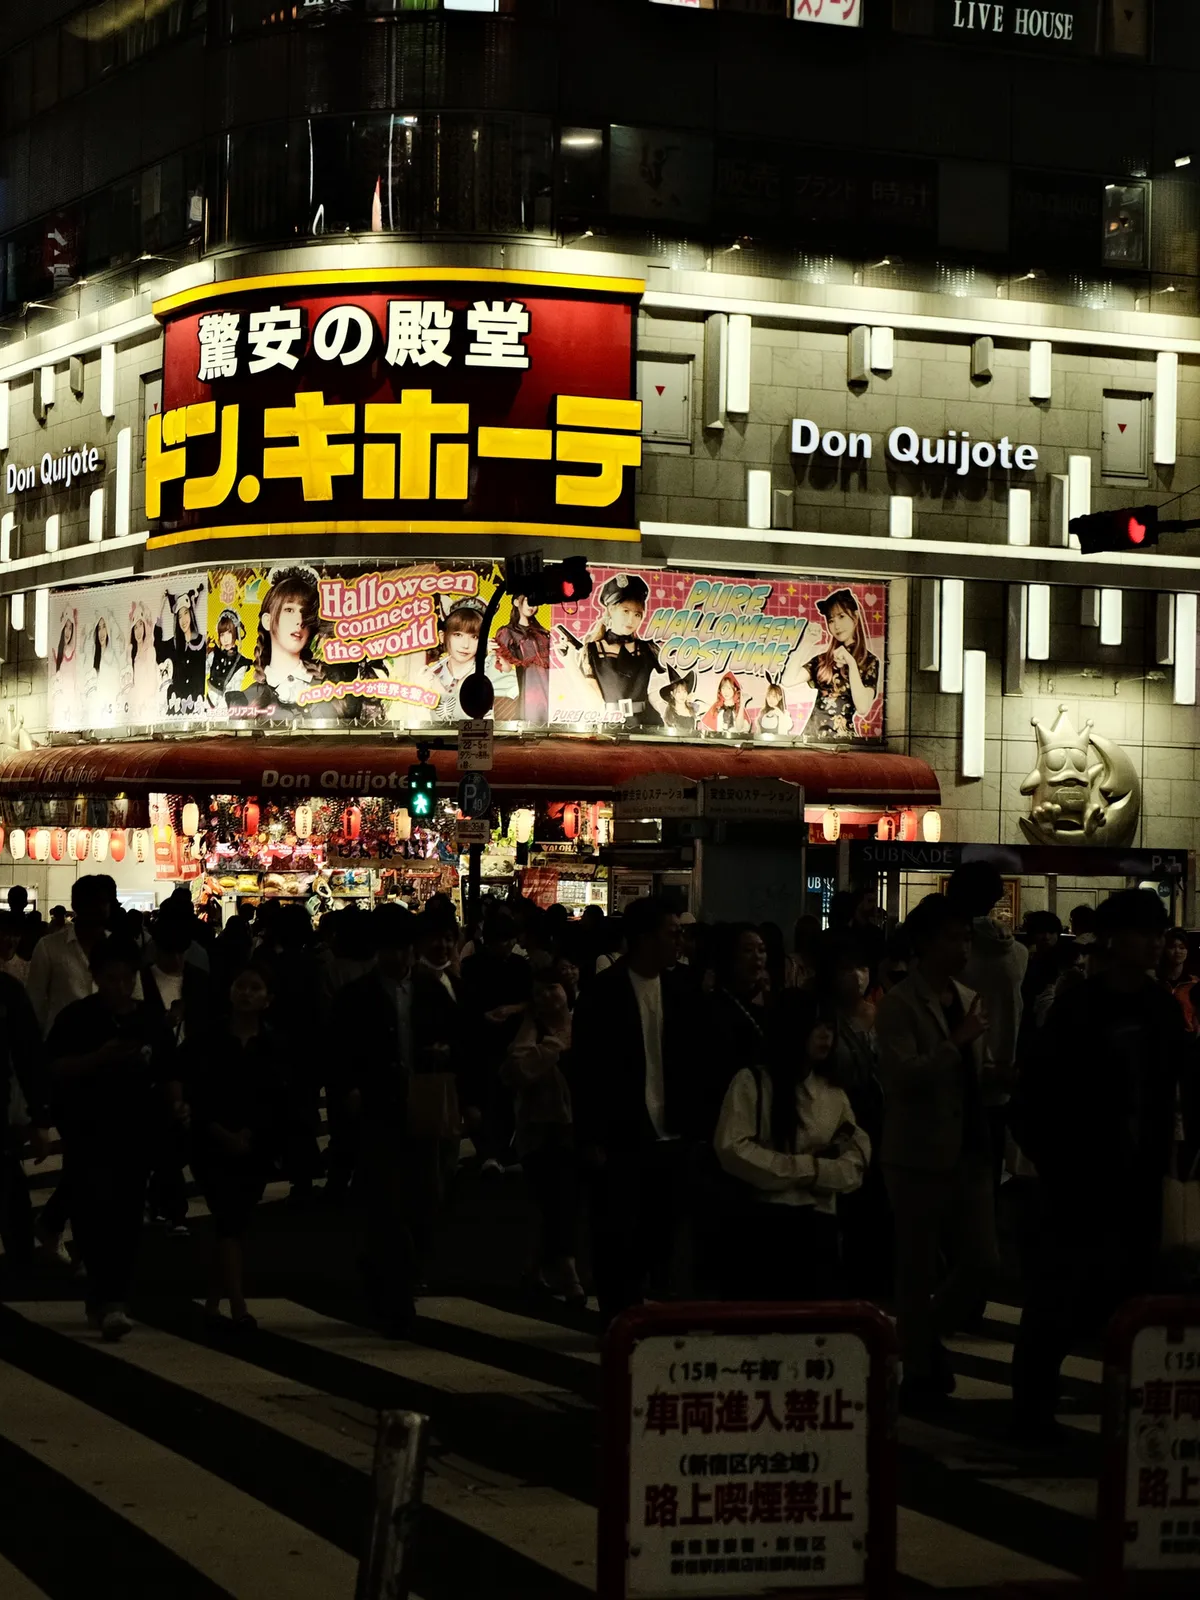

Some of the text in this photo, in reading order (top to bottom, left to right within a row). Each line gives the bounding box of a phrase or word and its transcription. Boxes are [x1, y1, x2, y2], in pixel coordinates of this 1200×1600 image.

[952, 0, 1074, 42] LIVE HOUSE
[197, 299, 531, 382] 驚安の殿堂
[791, 418, 1039, 476] Don Quijote
[6, 445, 100, 495] Don Quijote
[321, 572, 475, 619] Halloween
[685, 580, 773, 616] PURE
[337, 599, 432, 640] connects
[646, 607, 806, 646] HALLOWEEN
[324, 619, 435, 663] the world
[658, 636, 791, 674] COSTUME
[552, 709, 580, 723] PURE
[41, 764, 99, 786] Don Quijote
[261, 769, 411, 793] Don Quijote
[464, 783, 477, 811] P
[621, 788, 686, 801] 安全安心ステーショ
[862, 845, 954, 866] SUBNADE
[1152, 855, 1163, 872] P
[1164, 1351, 1200, 1374] (15
[644, 1387, 854, 1435] 車両進入禁止
[644, 1480, 853, 1527] 路上喫煙禁止
